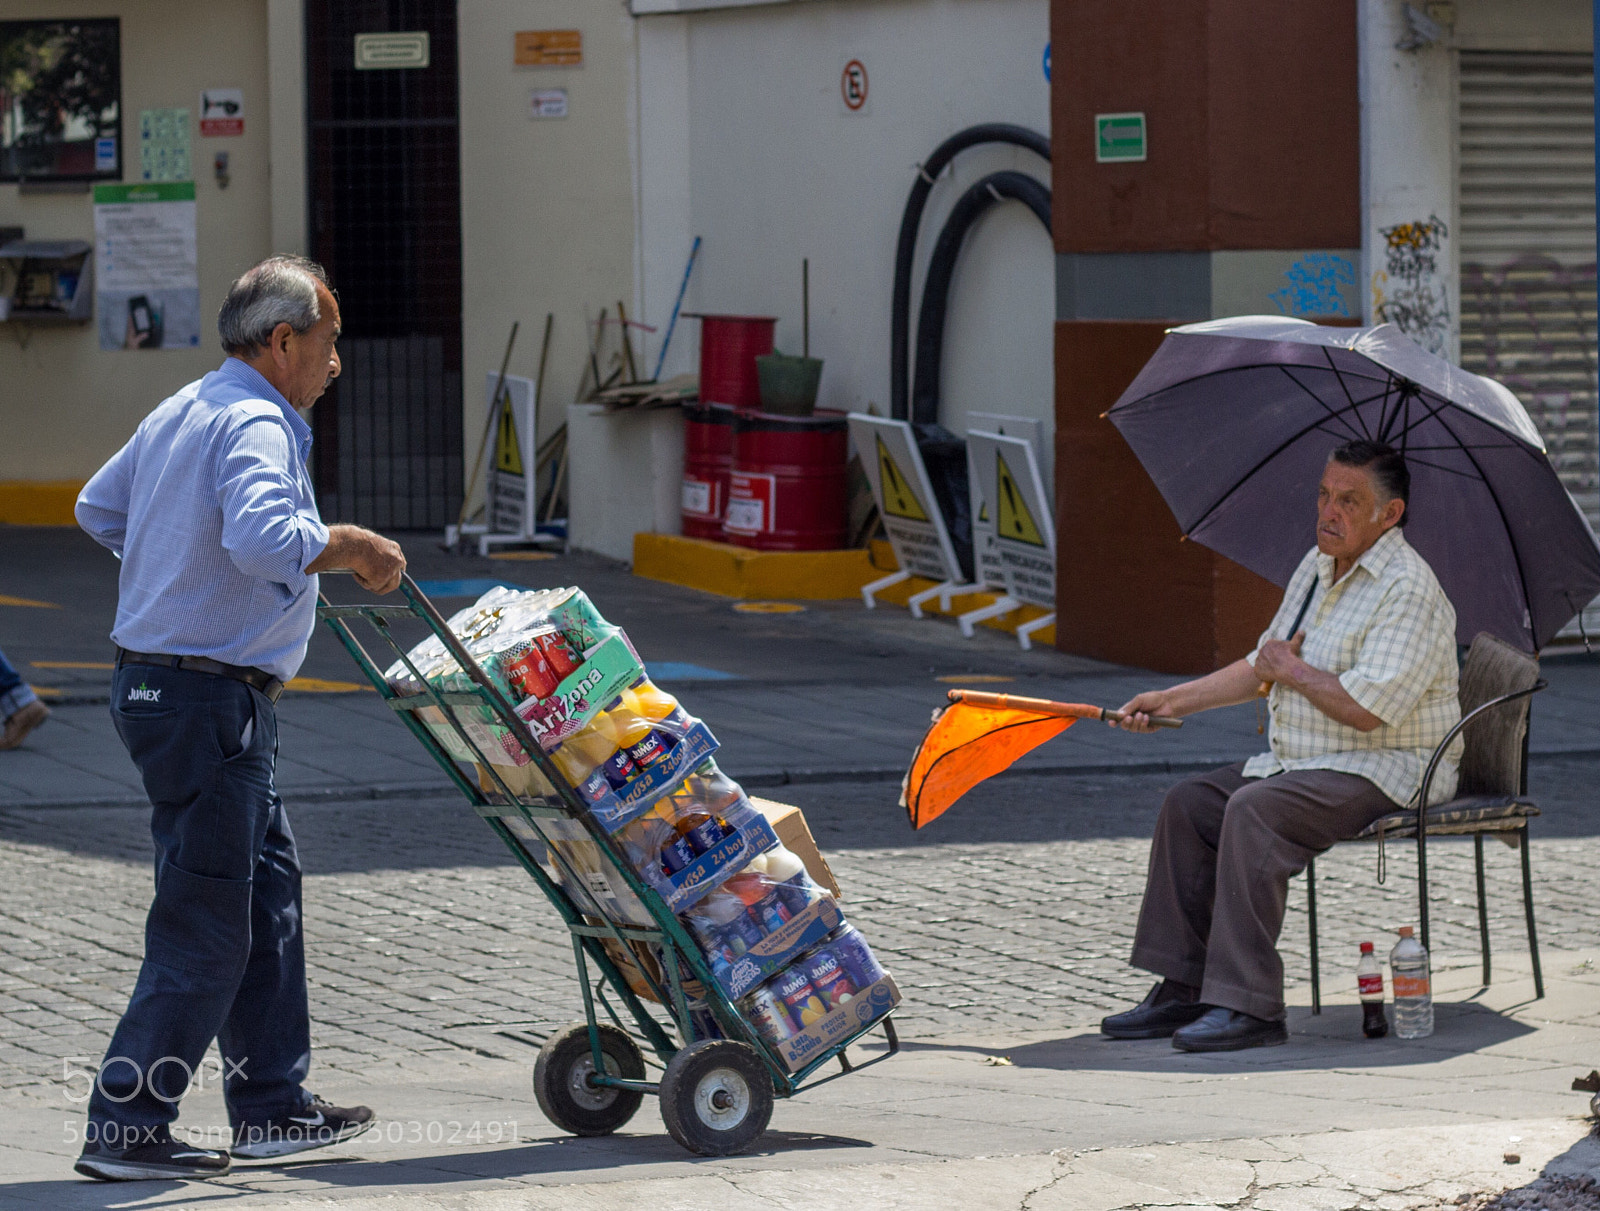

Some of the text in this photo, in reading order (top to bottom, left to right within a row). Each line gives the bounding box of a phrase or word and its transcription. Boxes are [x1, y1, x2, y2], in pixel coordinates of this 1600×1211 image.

[128, 688, 161, 702] JUMEX
[631, 736, 659, 760] JUMEX
[660, 731, 702, 776] 24 botllas
[711, 849, 726, 866] 24
[725, 825, 763, 856] botllas
[755, 834, 770, 850] ml
